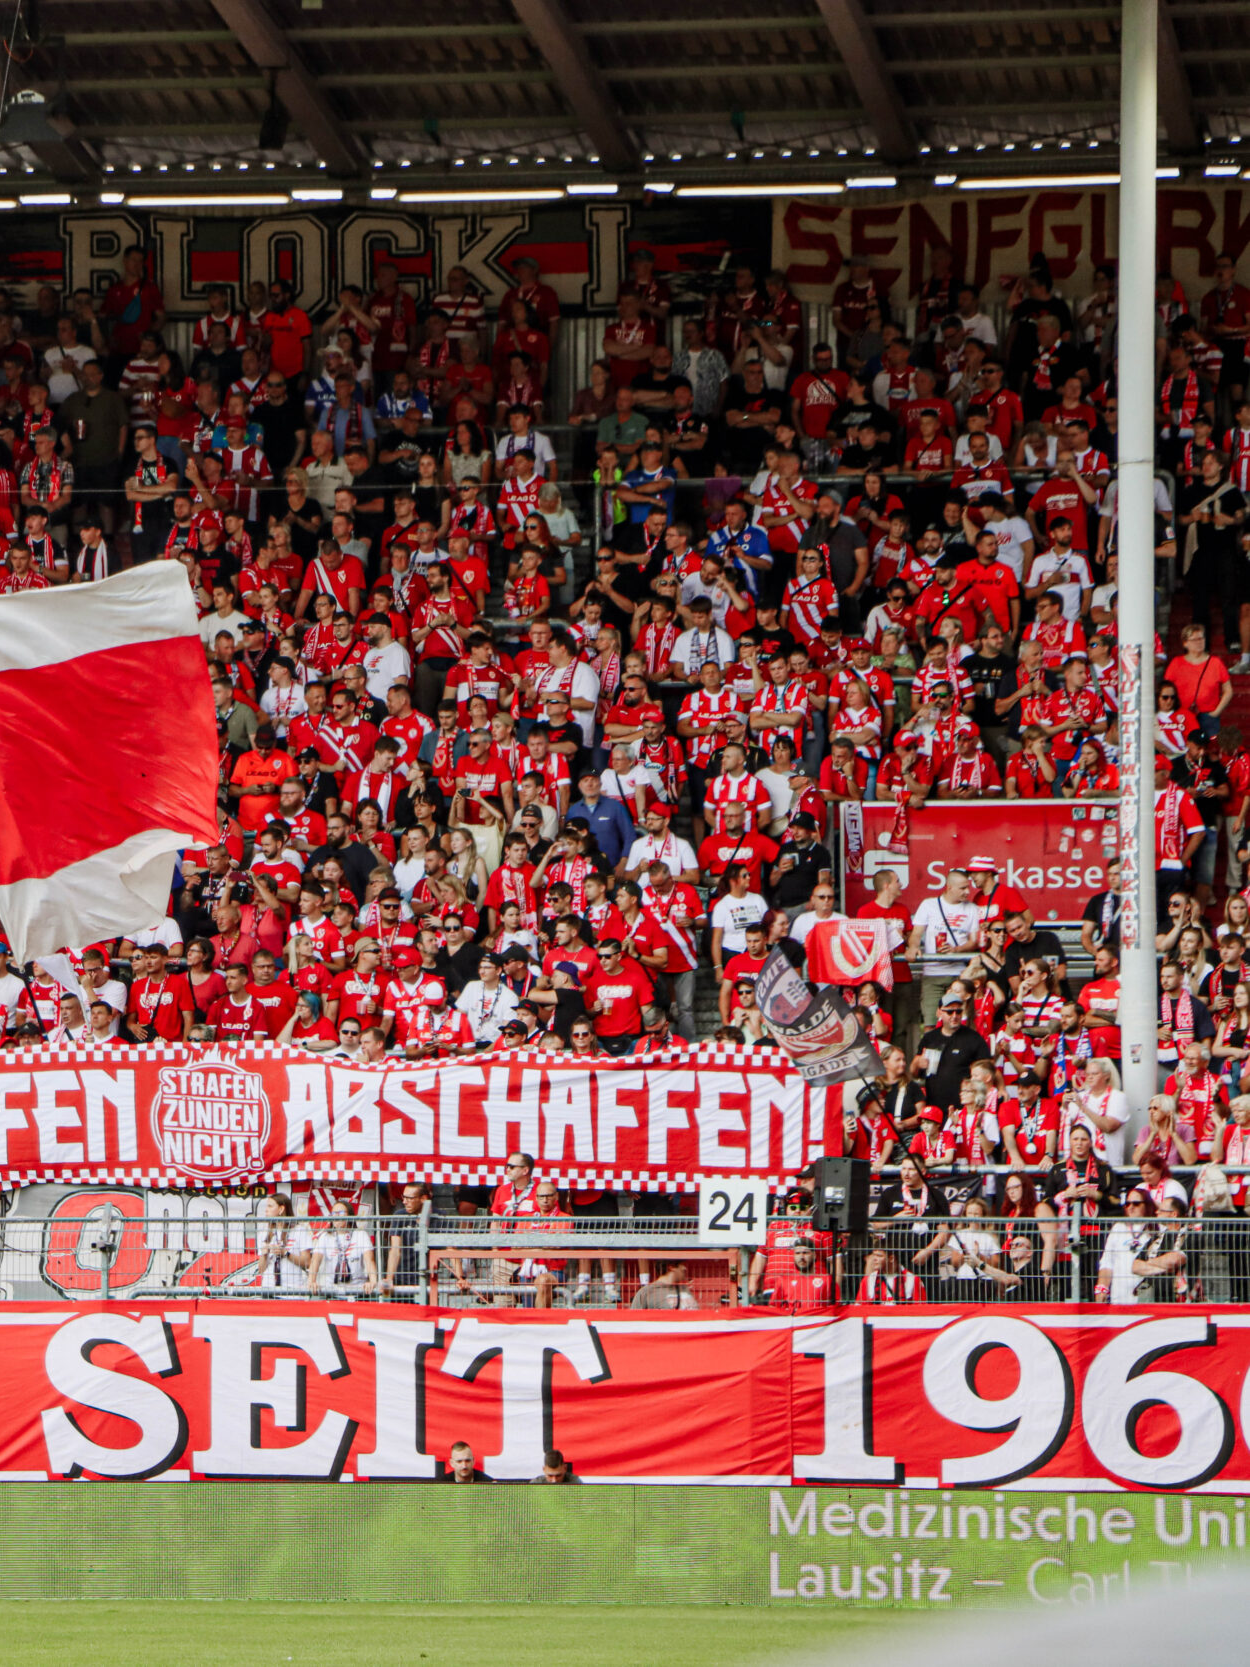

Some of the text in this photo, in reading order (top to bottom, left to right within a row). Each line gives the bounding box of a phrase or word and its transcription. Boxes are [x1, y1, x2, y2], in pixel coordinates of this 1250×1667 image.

[60, 211, 530, 318] BLOCK
[926, 858, 1104, 890] Skasse
[161, 1067, 260, 1099] STRAFEN
[162, 1096, 260, 1134] ZÜNDEN
[283, 1064, 827, 1168] ABSCHAFFEN!
[163, 1131, 263, 1169] NICHT!
[707, 1190, 758, 1232] 24
[41, 1313, 612, 1483] SEIT
[793, 1315, 1250, 1491] 196
[770, 1491, 1136, 1545] Medizinische
[770, 1552, 952, 1601] Lausitz
[1027, 1556, 1131, 1605] Carl
